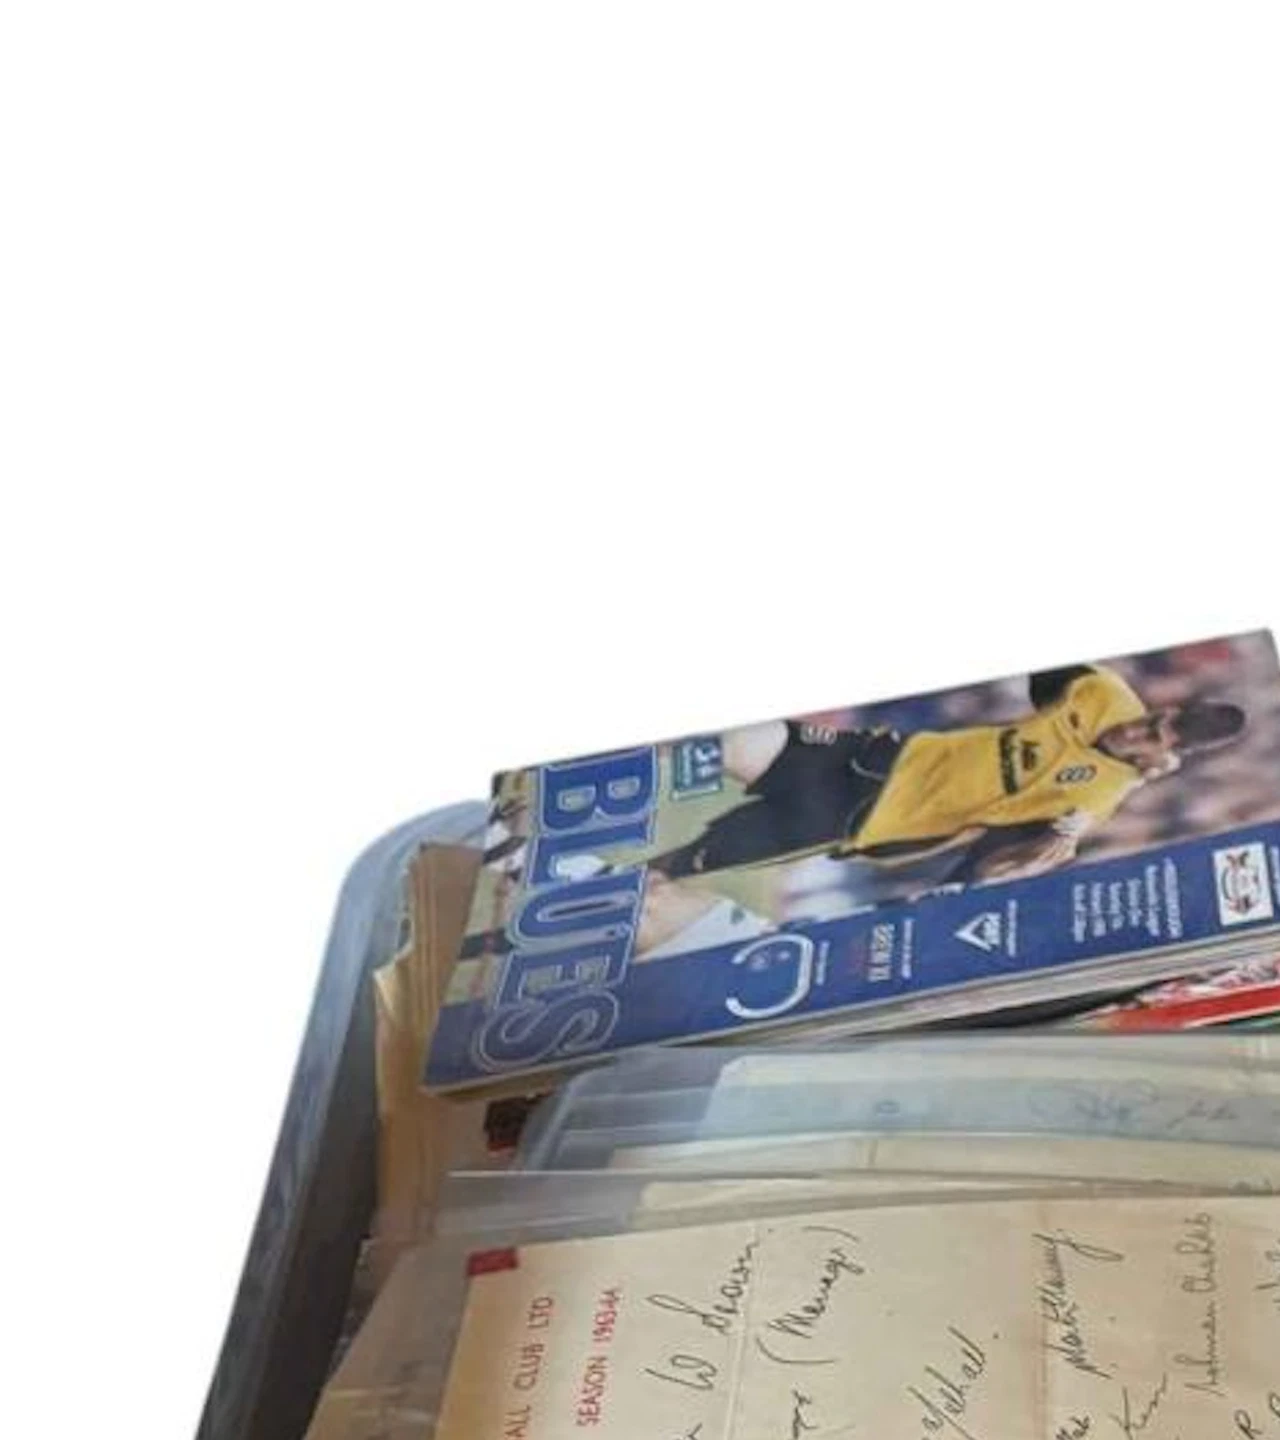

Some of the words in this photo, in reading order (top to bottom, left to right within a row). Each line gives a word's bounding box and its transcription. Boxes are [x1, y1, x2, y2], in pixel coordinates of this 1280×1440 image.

[474, 745, 658, 1078] BLUES
[521, 1331, 546, 1393] CLUB
[578, 1352, 607, 1427] SEASON
